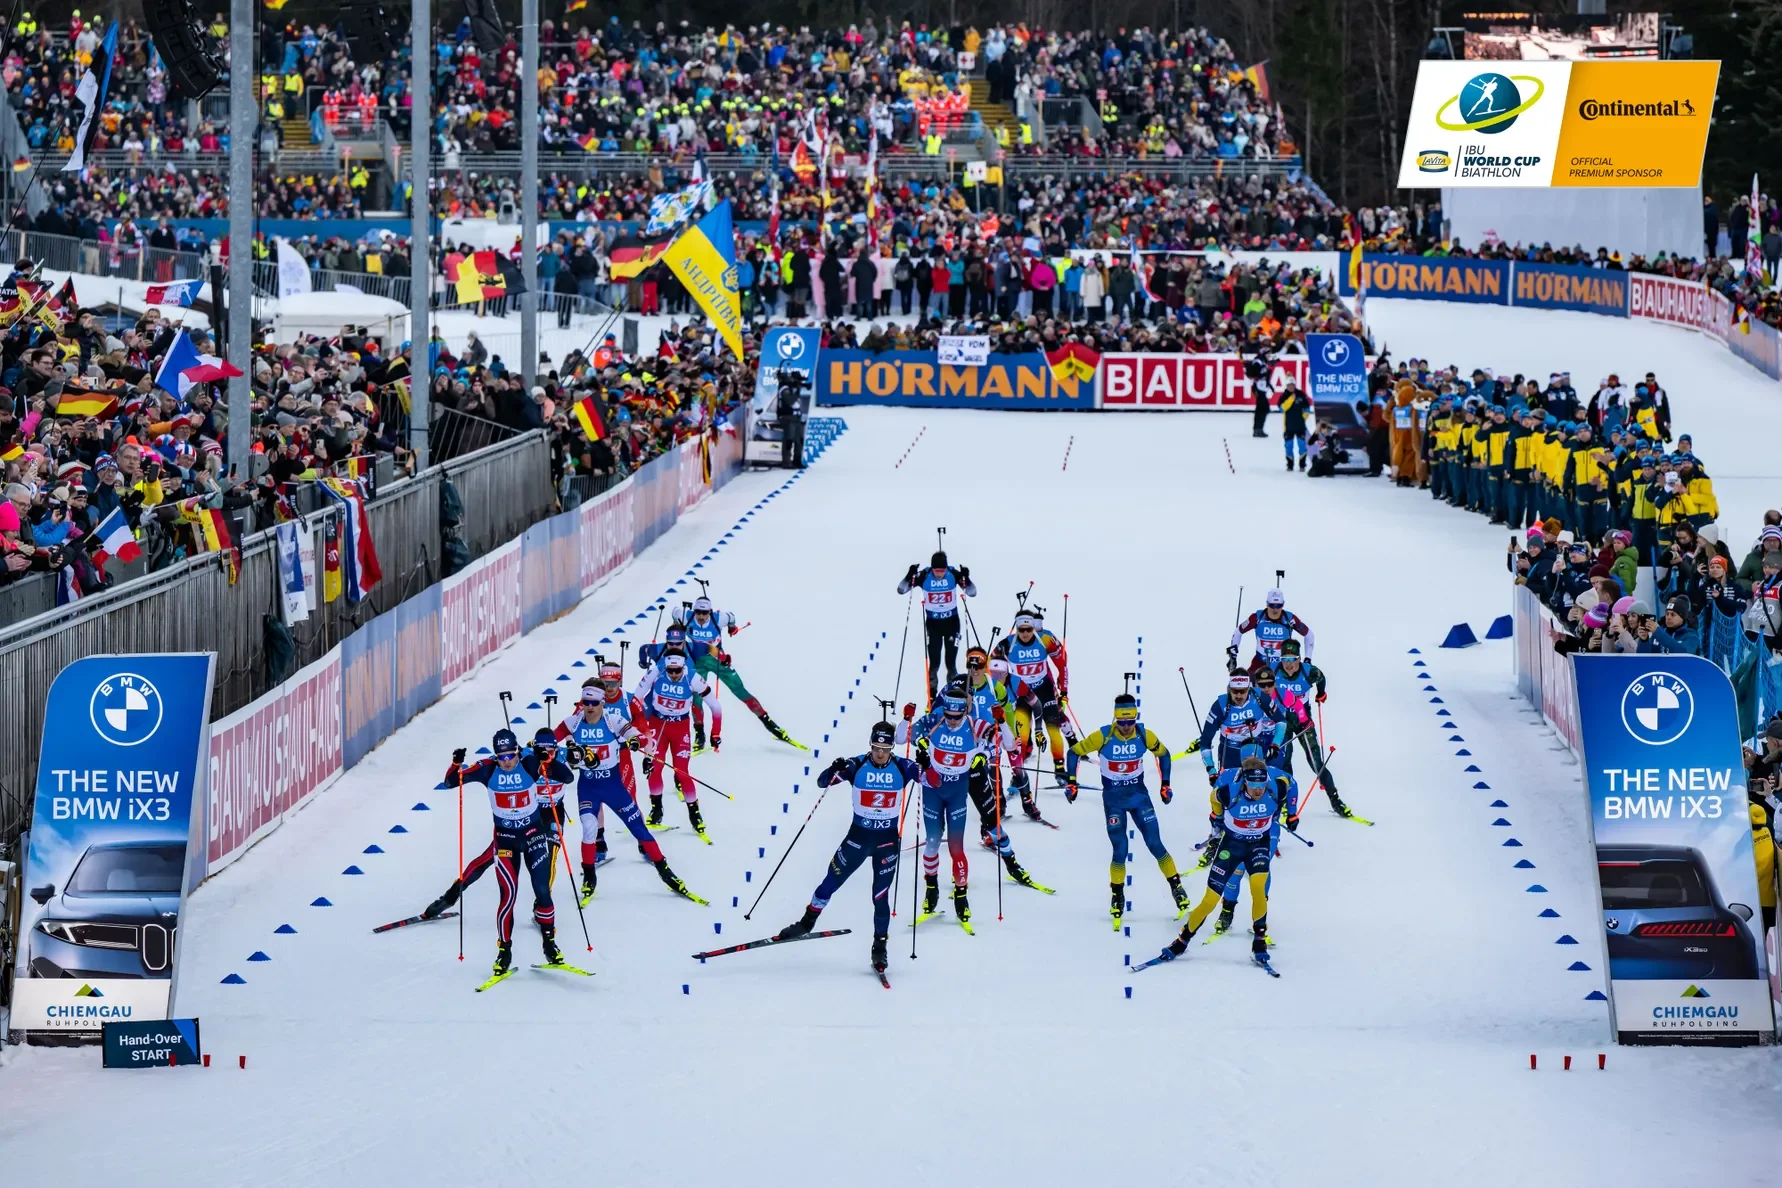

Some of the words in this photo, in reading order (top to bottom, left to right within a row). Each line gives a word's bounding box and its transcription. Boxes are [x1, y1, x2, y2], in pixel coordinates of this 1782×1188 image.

[1517, 261, 1624, 308] HÖRMANN
[680, 257, 742, 341] АНДРІЇВК
[1632, 282, 1703, 321] BAUHAUS
[830, 358, 1079, 399] HÖRMANN
[1107, 361, 1312, 399] BAUHA
[1316, 374, 1336, 383] THE
[1339, 374, 1363, 383] NEW
[1316, 383, 1342, 393] BMW
[1343, 383, 1360, 393] iX3
[931, 579, 948, 588] DKB
[692, 630, 713, 638] DKB
[1263, 626, 1284, 636] DKB
[1018, 649, 1040, 659] DKB
[99, 676, 153, 698] BMW
[661, 683, 684, 695] DKB
[1631, 675, 1685, 696] BMW
[1231, 709, 1254, 721] DKB
[581, 728, 604, 739] DKB
[940, 734, 963, 746] DKB
[1112, 744, 1137, 755] DKB
[943, 754, 956, 765] 5
[498, 773, 522, 785] DKB
[595, 770, 611, 779] iX3
[866, 772, 893, 784] DKB
[1603, 768, 1661, 792] THE
[1668, 768, 1731, 791] NEW
[51, 770, 108, 793] THE
[116, 770, 179, 793] NEW
[507, 793, 517, 808] 1
[872, 793, 885, 807] 2
[52, 797, 123, 820] BMW
[128, 797, 171, 820] iX3
[1240, 804, 1267, 815] DKB
[1604, 796, 1672, 819] BMW
[1680, 796, 1722, 819] iX3
[514, 817, 531, 828] iX3
[873, 820, 891, 829] iX3
[957, 860, 966, 883] USA
[46, 1005, 132, 1018] CHIEMGAU
[1652, 1006, 1738, 1019] CHIEMGAU
[119, 1034, 183, 1046] Hand-Over
[131, 1049, 172, 1061] START
